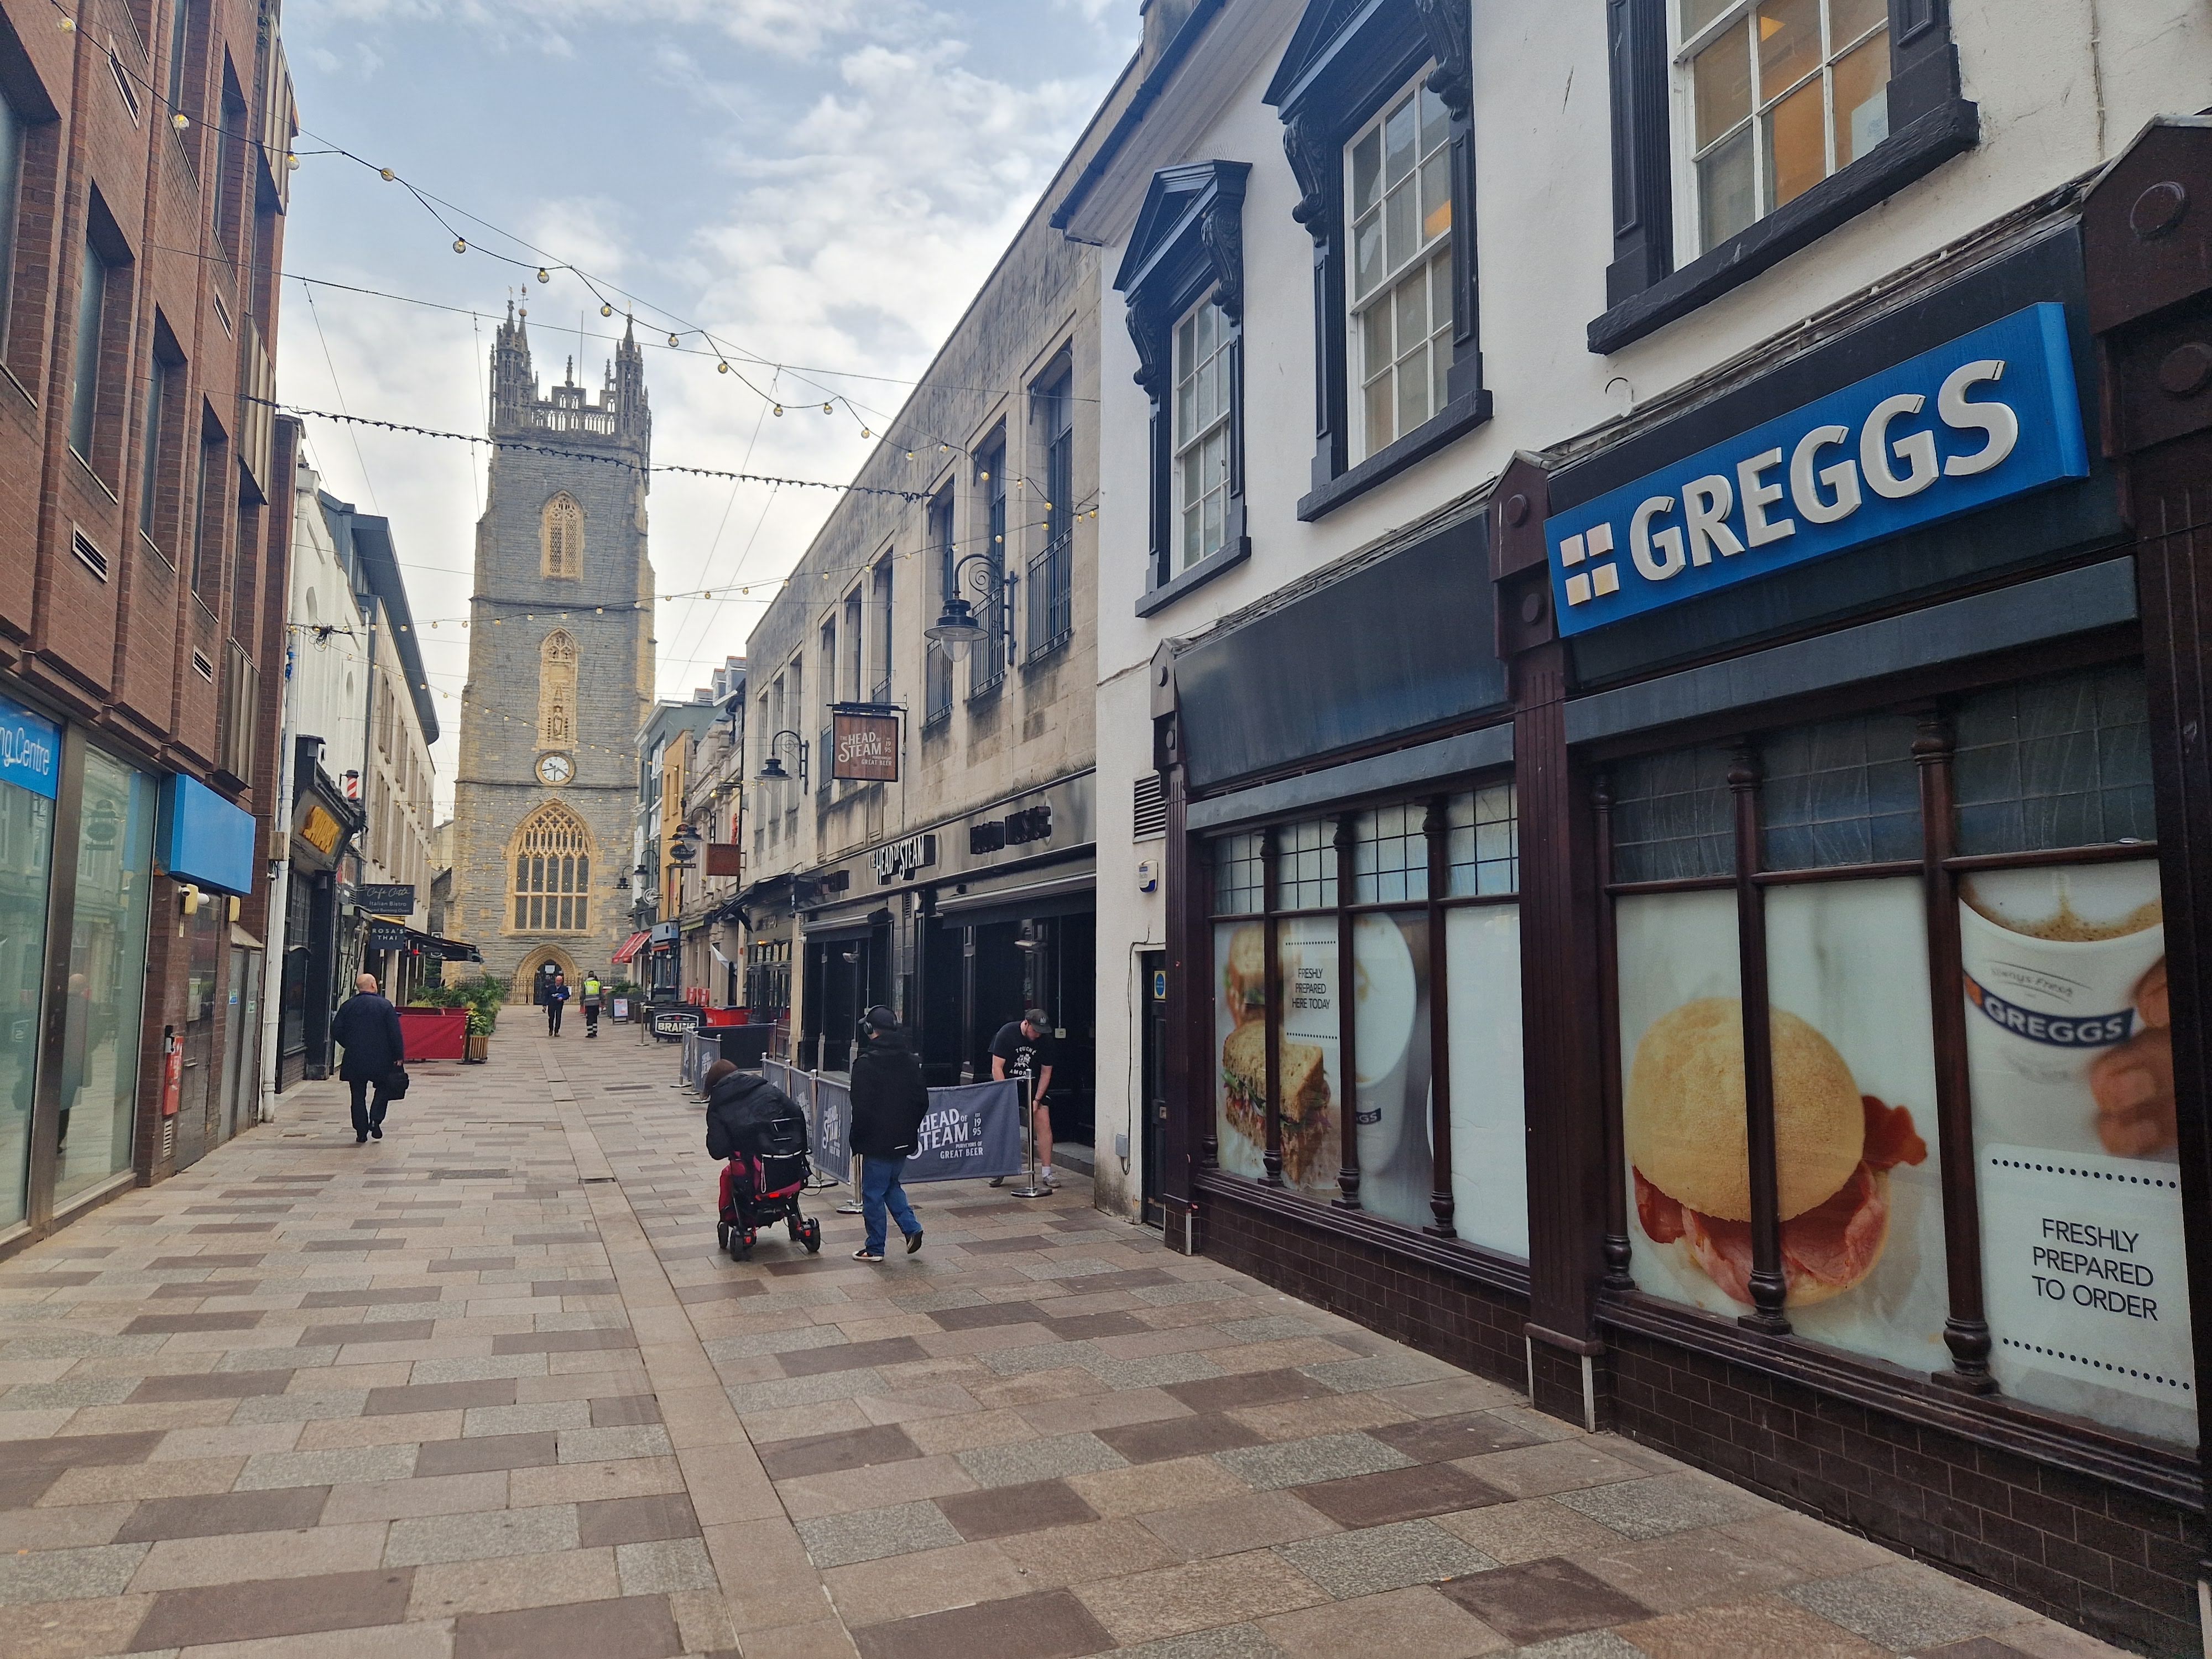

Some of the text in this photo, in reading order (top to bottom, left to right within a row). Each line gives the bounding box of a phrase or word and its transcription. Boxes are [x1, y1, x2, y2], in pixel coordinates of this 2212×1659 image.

[1629, 359, 2018, 581] GREGGS
[848, 732, 876, 745] HEAD
[15, 727, 50, 776] Centre
[838, 742, 881, 763] STEAM
[877, 846, 893, 885] HEAD
[894, 843, 900, 860] OF
[899, 836, 924, 880] STEAM
[1298, 968, 1323, 978] FRESHLY
[1295, 983, 1326, 994] PREPARED
[1292, 998, 1330, 1009] HERE TODAY
[1984, 995, 2123, 1042] GREGGS
[920, 1108, 959, 1133] HEAD
[972, 1126, 982, 1136] 95
[974, 1118, 982, 1127] 19
[940, 1147, 983, 1159] GREAT BEER
[2042, 1218, 2140, 1254] FRESHLY
[2032, 1246, 2154, 1287] PREPARED
[2031, 1275, 2158, 1322] TO ORDER
